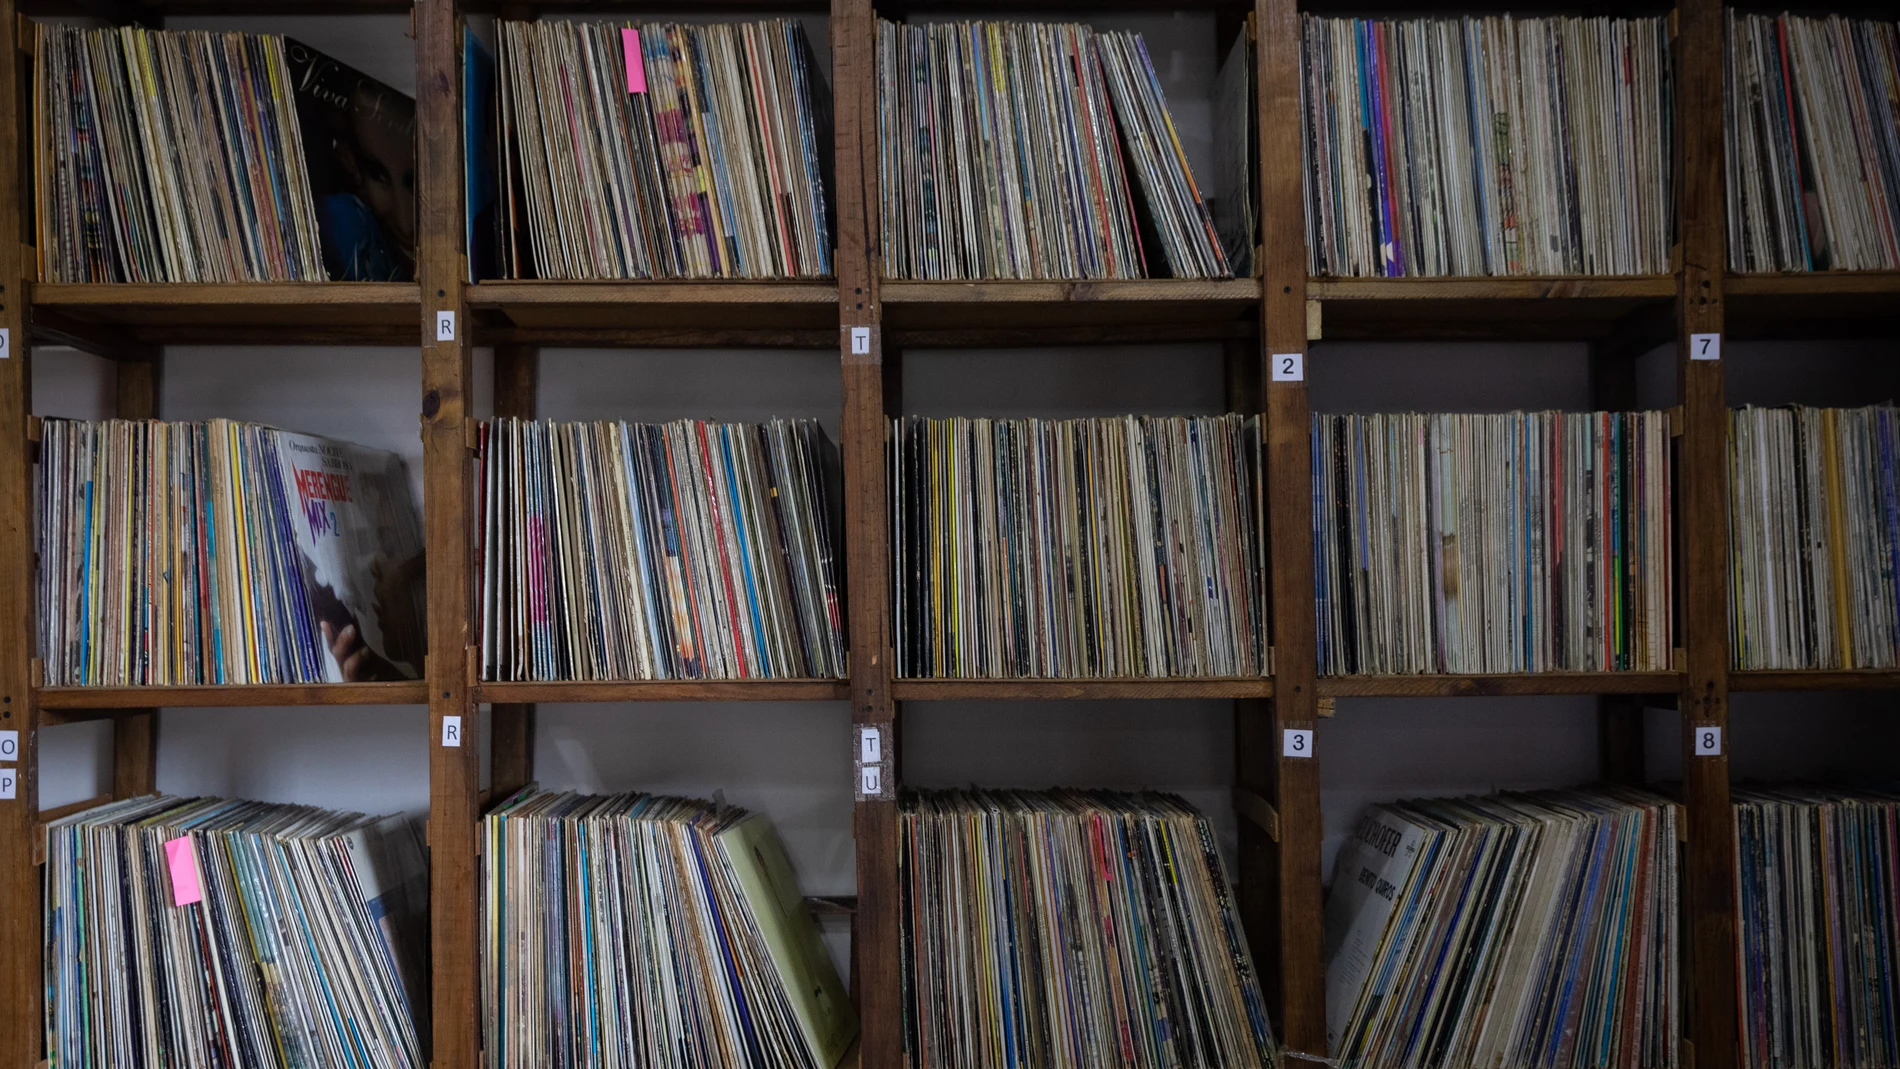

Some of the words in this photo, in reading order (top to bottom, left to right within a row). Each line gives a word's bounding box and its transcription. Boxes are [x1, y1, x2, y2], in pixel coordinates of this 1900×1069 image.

[290, 45, 349, 112] Viva
[441, 319, 452, 335] R
[855, 335, 867, 351] T
[1700, 338, 1711, 355] 7
[1282, 357, 1294, 374] 2
[291, 457, 353, 518] MERENGUE
[303, 492, 331, 547] MIX
[330, 511, 340, 537] 2
[447, 724, 457, 740] R
[1, 739, 15, 755] O
[865, 737, 876, 752] T
[1293, 734, 1304, 751] 3
[1703, 732, 1715, 749] 8
[2, 777, 12, 793] P
[866, 775, 877, 790] U
